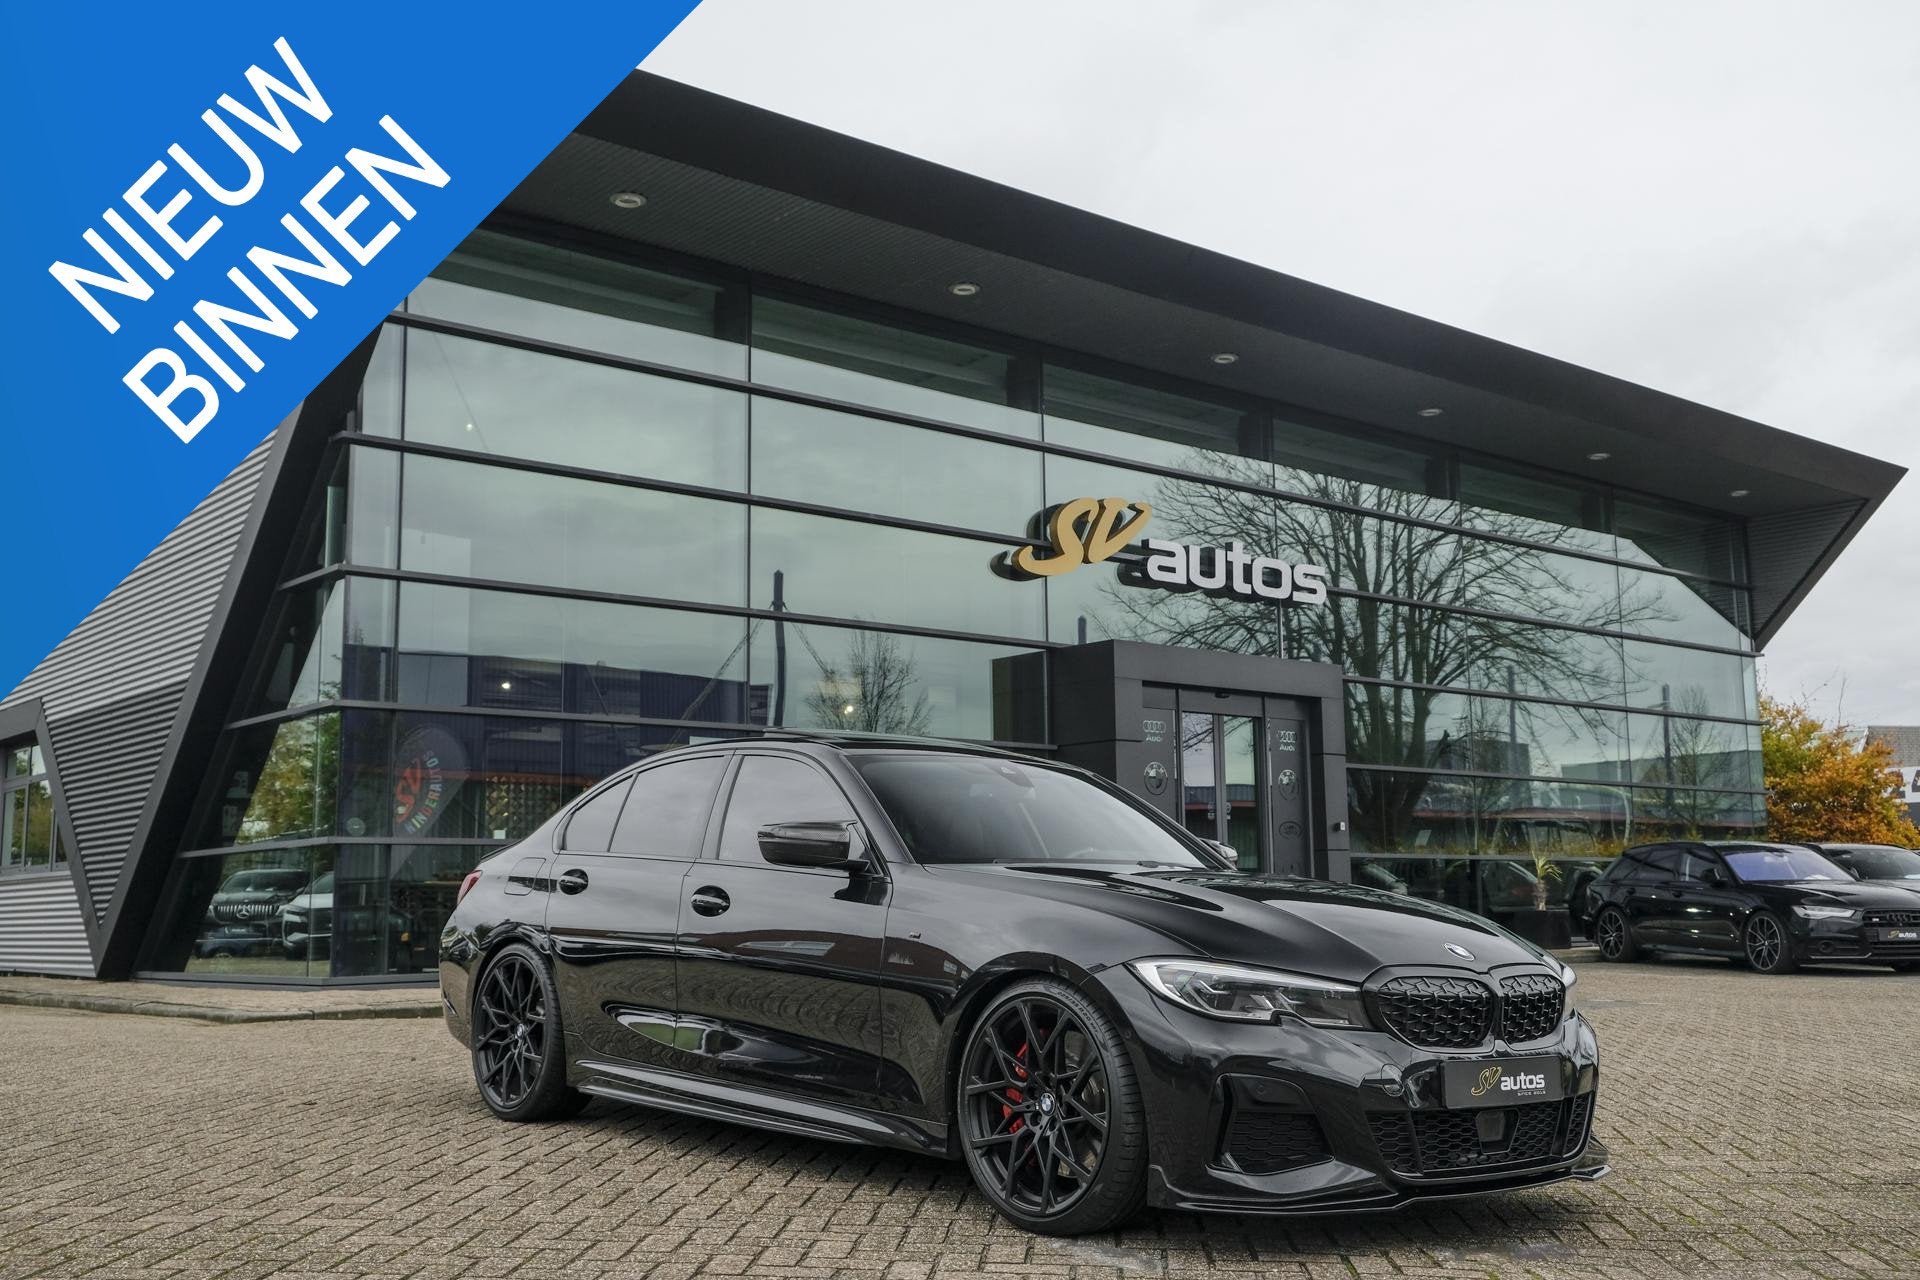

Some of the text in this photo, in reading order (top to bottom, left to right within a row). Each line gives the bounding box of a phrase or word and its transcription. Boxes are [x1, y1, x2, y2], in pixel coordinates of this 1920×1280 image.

[1012, 496, 1328, 604] SV autos
[1471, 1067, 1545, 1096] SV autos
